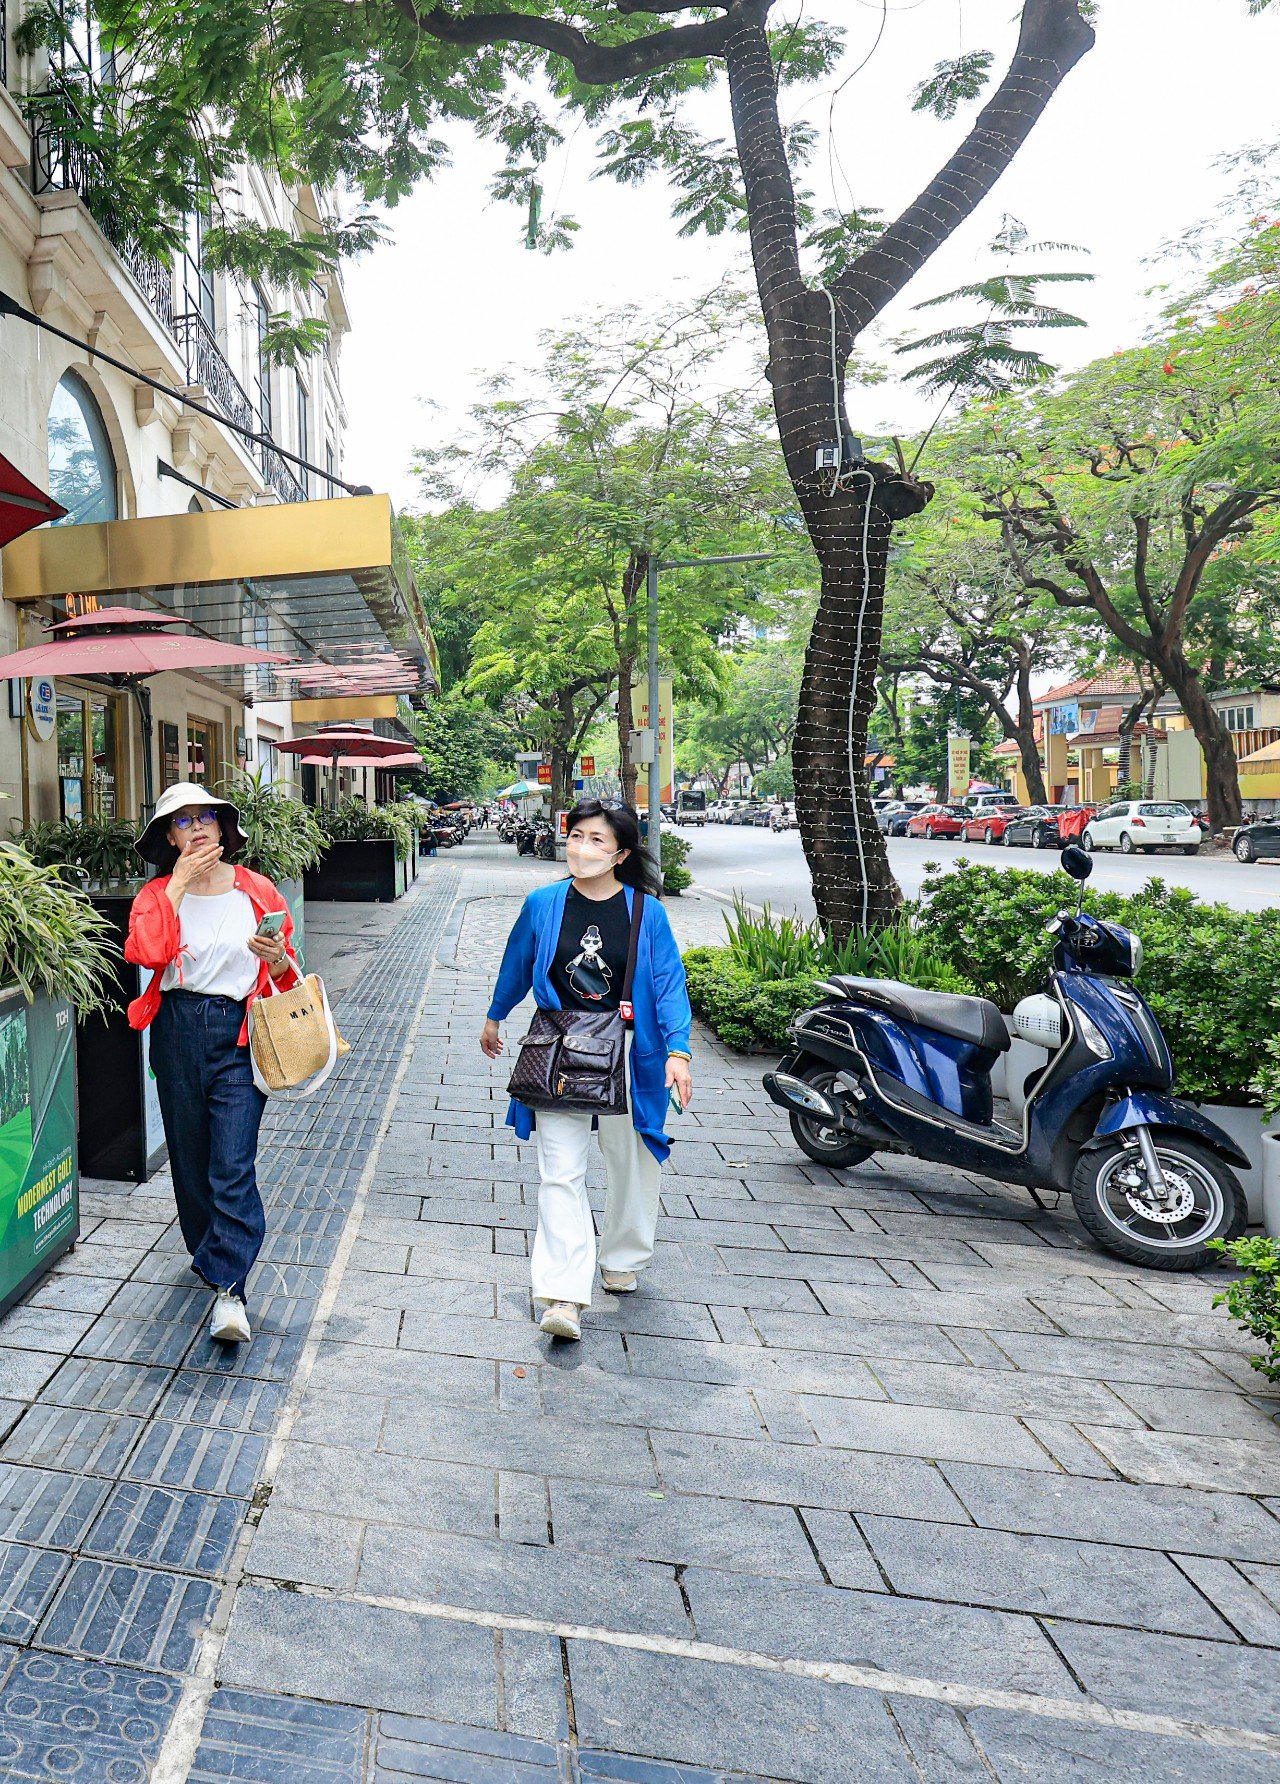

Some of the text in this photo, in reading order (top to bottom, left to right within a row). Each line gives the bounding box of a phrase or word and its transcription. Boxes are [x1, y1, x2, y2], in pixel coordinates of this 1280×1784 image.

[17, 1155, 73, 1219] MODERNEST GOLF
[33, 1179, 73, 1232] TECHNOLOGY
